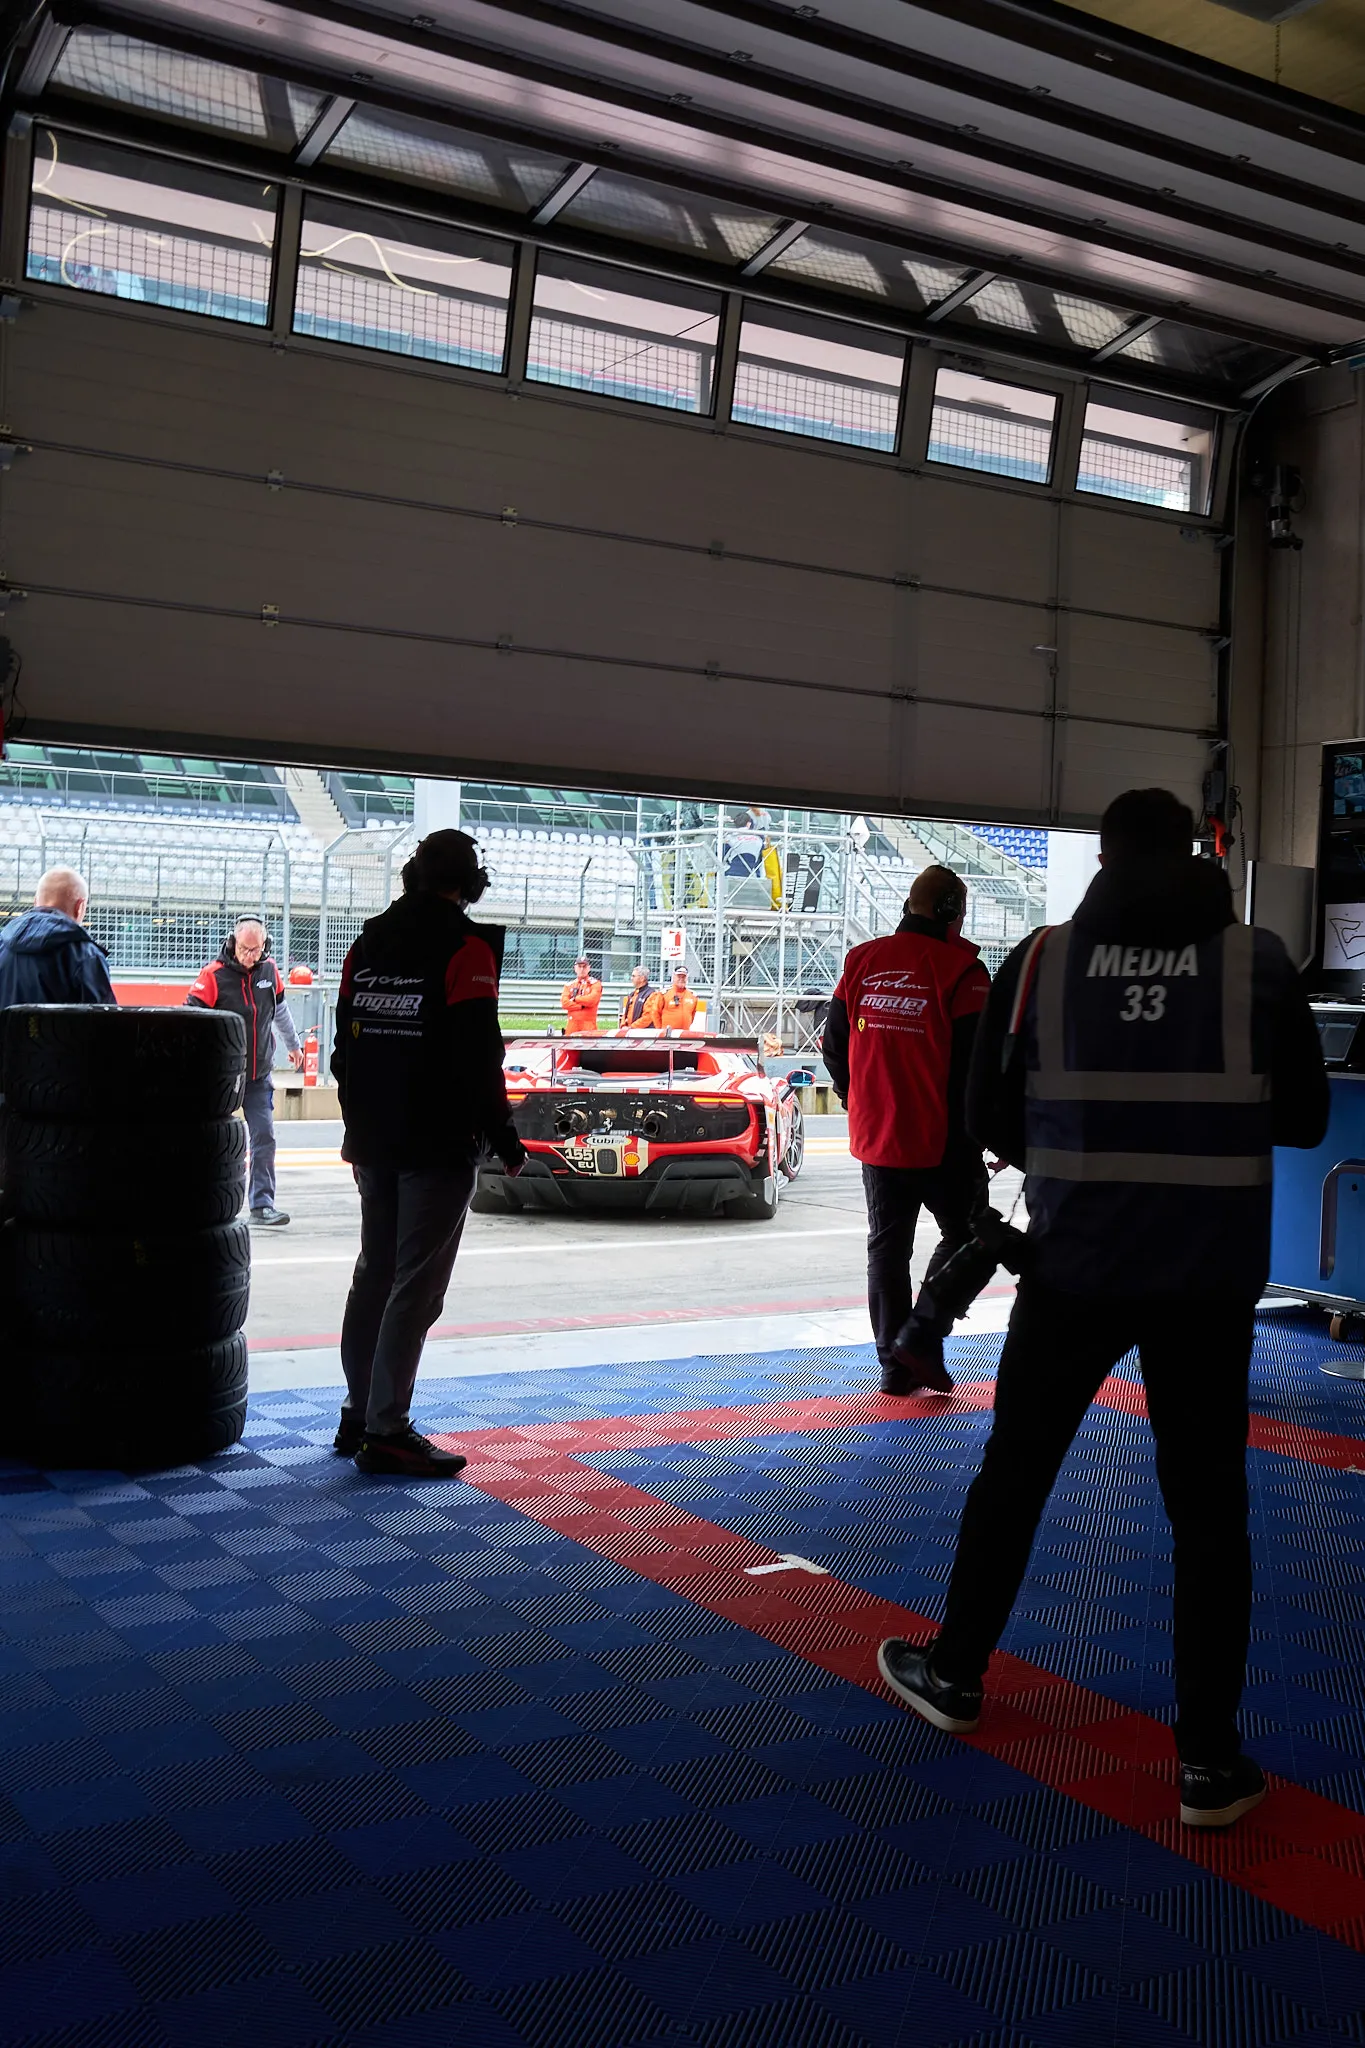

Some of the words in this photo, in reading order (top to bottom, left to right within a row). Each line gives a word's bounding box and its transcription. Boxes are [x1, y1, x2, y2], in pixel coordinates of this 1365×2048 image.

[1086, 944, 1199, 977] MEDIA
[1119, 985, 1167, 1022] 33
[376, 1008, 419, 1017] motorsport
[881, 1008, 922, 1017] motorsport
[564, 1148, 593, 1160] 155
